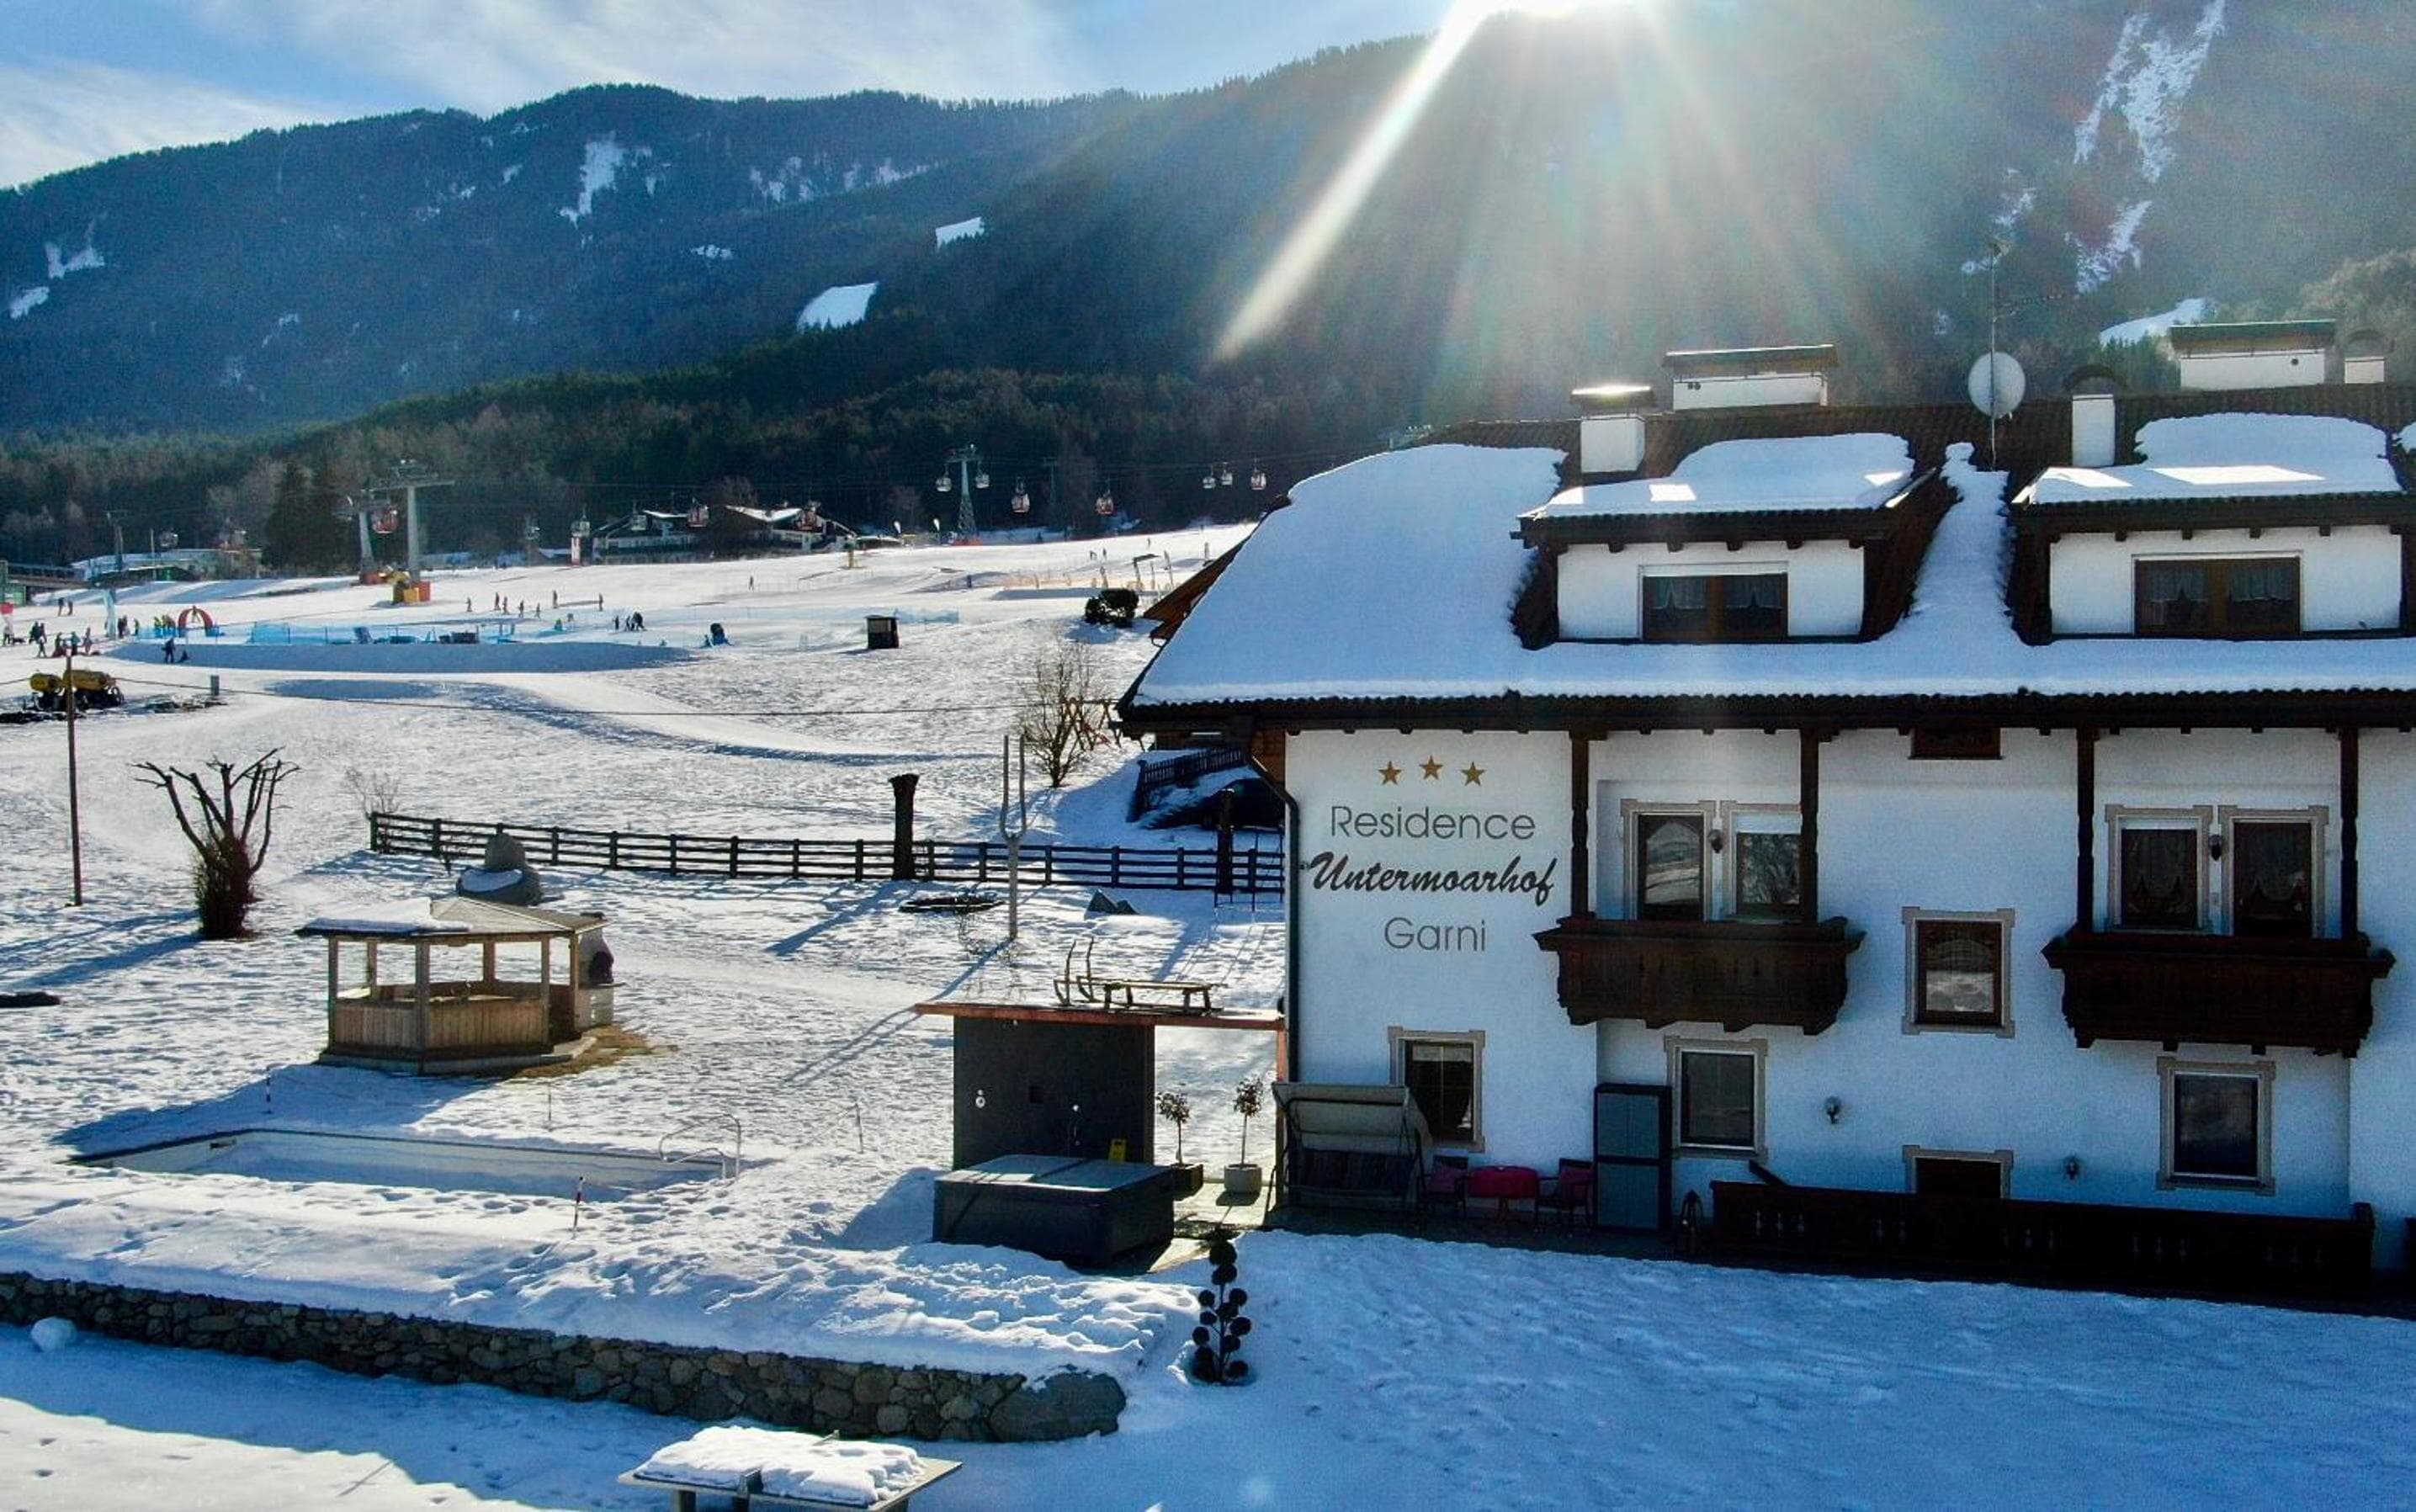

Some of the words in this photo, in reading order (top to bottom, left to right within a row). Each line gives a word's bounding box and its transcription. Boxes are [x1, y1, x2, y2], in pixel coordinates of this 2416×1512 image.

[1330, 806, 1536, 840] Residence
[1310, 851, 1558, 906] Untermoarhof
[1384, 917, 1485, 952] Garni
